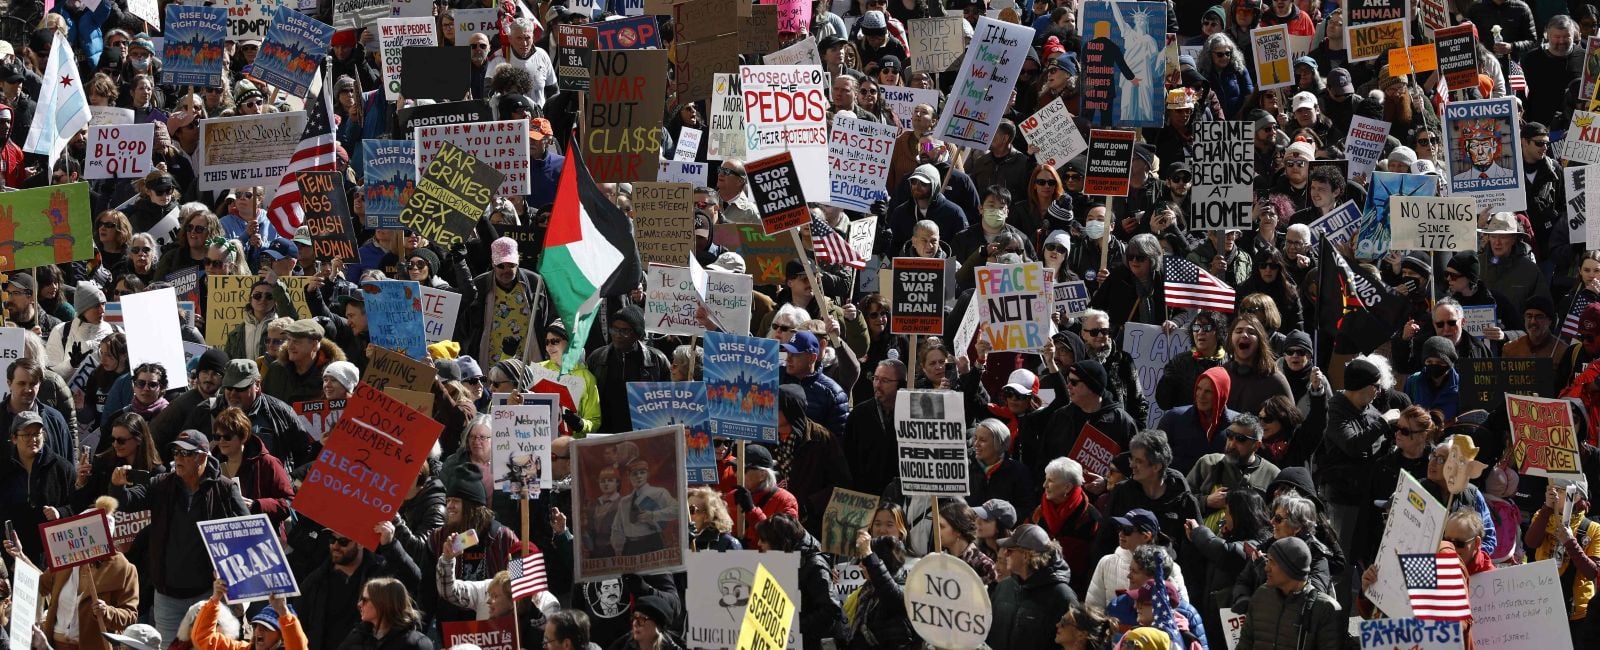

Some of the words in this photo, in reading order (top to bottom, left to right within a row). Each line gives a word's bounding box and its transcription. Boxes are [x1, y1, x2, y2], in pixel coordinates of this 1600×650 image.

[179, 12, 200, 20] RISE
[1352, 8, 1400, 20] HUMAN
[171, 21, 198, 30] FIGHT
[200, 22, 223, 32] BACK
[287, 17, 308, 28] RISE
[382, 26, 393, 36] WE
[394, 26, 406, 34] THE
[407, 24, 432, 34] PEOPLE
[560, 26, 574, 34] FROM
[912, 18, 958, 38] PROTEST
[276, 23, 301, 35] FIGHT
[302, 31, 325, 48] BACK
[566, 36, 588, 48] RIVER
[1356, 27, 1378, 46] NO
[1440, 40, 1454, 48] SHUT
[1454, 36, 1470, 44] DOWN
[920, 36, 944, 52] SIZE
[1087, 42, 1104, 51] Keep
[568, 56, 582, 66] SEA
[595, 52, 628, 76] NO
[915, 52, 960, 68] MATTERS
[1086, 54, 1102, 62] your
[742, 67, 810, 84] Prosecute
[1086, 78, 1111, 86] fingers
[594, 76, 647, 102] WAR
[768, 84, 798, 92] THE
[744, 90, 824, 122] PEDOS
[1086, 102, 1108, 110] liberty
[1447, 107, 1468, 118] NO
[1470, 104, 1510, 116] KINGS
[406, 114, 466, 128] ABORTION
[468, 112, 480, 122] IS
[591, 102, 638, 128] BUT
[712, 115, 734, 130] FAUX
[1020, 116, 1038, 133] NO
[1039, 100, 1064, 122] KINGS
[99, 128, 120, 140] NO
[252, 124, 292, 144] People
[422, 128, 438, 138] NO
[444, 125, 472, 135] NEW
[478, 122, 522, 132] WARS?
[1193, 122, 1253, 141] REGIME
[1357, 122, 1385, 132] BECAUSE
[466, 137, 490, 146] YOU
[496, 135, 521, 144] CAN
[589, 128, 663, 154] CLA$$
[758, 130, 780, 145] THEIR
[781, 127, 826, 146] PROTECTORS
[1350, 128, 1386, 143] FREEDOM
[95, 140, 146, 159] BLOOD
[376, 147, 400, 155] RISE
[832, 131, 892, 156] FASCIST
[1094, 142, 1109, 150] SHUT
[1110, 142, 1128, 150] DOWN
[1354, 140, 1378, 150] CAN'T
[436, 142, 476, 174] WAR
[830, 147, 844, 156] and
[1193, 142, 1254, 163] CHANGE
[1347, 145, 1380, 160] PROTECT
[90, 160, 103, 168] FOR
[106, 159, 142, 174] OIL
[369, 157, 396, 167] FIGHT
[586, 153, 643, 182] WAR
[682, 164, 702, 174] NOT
[204, 172, 228, 182] THIS
[754, 166, 790, 184] STOP
[1090, 166, 1128, 174] OCCUPATION!
[1193, 162, 1254, 186] BEGINS
[300, 173, 334, 192] TEMU
[428, 160, 491, 205] CRIMES
[760, 178, 790, 193] WAR
[836, 174, 856, 182] must
[1453, 180, 1480, 190] RESIST
[1482, 178, 1516, 187] FASCISM
[635, 187, 690, 200] PROTECT
[768, 190, 788, 200] ON
[1208, 186, 1234, 198] AT
[302, 196, 332, 214] ASS
[409, 192, 452, 224] SEX
[634, 202, 656, 212] FREE
[658, 201, 689, 212] SPEECH
[762, 194, 800, 214] IRAN!
[1192, 201, 1252, 228] HOME
[1400, 202, 1420, 218] NO
[1427, 202, 1474, 222] KINGS
[308, 216, 344, 236] BUSH
[400, 208, 463, 251] CRIMES
[636, 217, 690, 227] PROTECT
[1418, 222, 1450, 233] SINCE
[637, 229, 692, 240] IMMIGRANTS
[1420, 234, 1457, 250] 1776
[314, 240, 354, 260] ADMIN
[637, 242, 688, 251] PROTECT
[639, 253, 690, 263] DEMOCRACY
[214, 276, 230, 288] IF
[900, 272, 938, 282] STOP
[977, 264, 1042, 296] PEACE
[707, 276, 734, 294] takes
[902, 282, 934, 292] WAR
[908, 292, 928, 302] ON
[214, 306, 244, 320] NOT
[899, 302, 937, 313] IRAN!
[988, 295, 1038, 324] NOT
[895, 318, 918, 326] TRUMP
[920, 318, 939, 326] MUST
[981, 323, 1043, 351] WAR
[719, 342, 746, 352] RISE
[748, 344, 766, 356] UP
[371, 352, 417, 384] WAITING
[710, 353, 742, 364] FIGHT
[744, 355, 775, 372] BACK
[1474, 361, 1493, 372] WAR
[644, 390, 672, 400] RISE
[674, 390, 693, 399] UP
[304, 402, 324, 412] JUST
[330, 400, 346, 408] SAY
[356, 384, 416, 422] COMING
[636, 400, 670, 414] FIGHT
[672, 400, 704, 412] BACK
[358, 405, 404, 436] SOON
[898, 420, 938, 440] JUSTICE
[940, 421, 963, 440] FOR
[339, 418, 414, 464] NUREMBERG
[900, 448, 964, 460] RENEE
[320, 448, 400, 498] ELECTRIC
[900, 462, 934, 479] NICOLE
[936, 462, 966, 480] GOOD
[308, 469, 392, 514] BOOGALOO
[52, 528, 74, 542] THIS
[79, 526, 88, 536] IS
[204, 523, 229, 533] SUPPORT
[242, 520, 264, 528] TROOPS
[68, 538, 86, 550] NOT
[209, 542, 229, 558] NO
[218, 539, 281, 586] IRAN
[583, 558, 607, 570] OBEY
[611, 555, 637, 566] YOUR
[639, 550, 680, 564] LEADERS
[261, 572, 292, 588] WAR
[924, 574, 961, 600] NO
[762, 578, 786, 620] BUILD
[750, 594, 786, 648] SCHOOLS
[911, 601, 986, 636] KINGS
[451, 631, 500, 646] DISSENT
[502, 630, 512, 640] is
[692, 628, 725, 642] LUIGI
